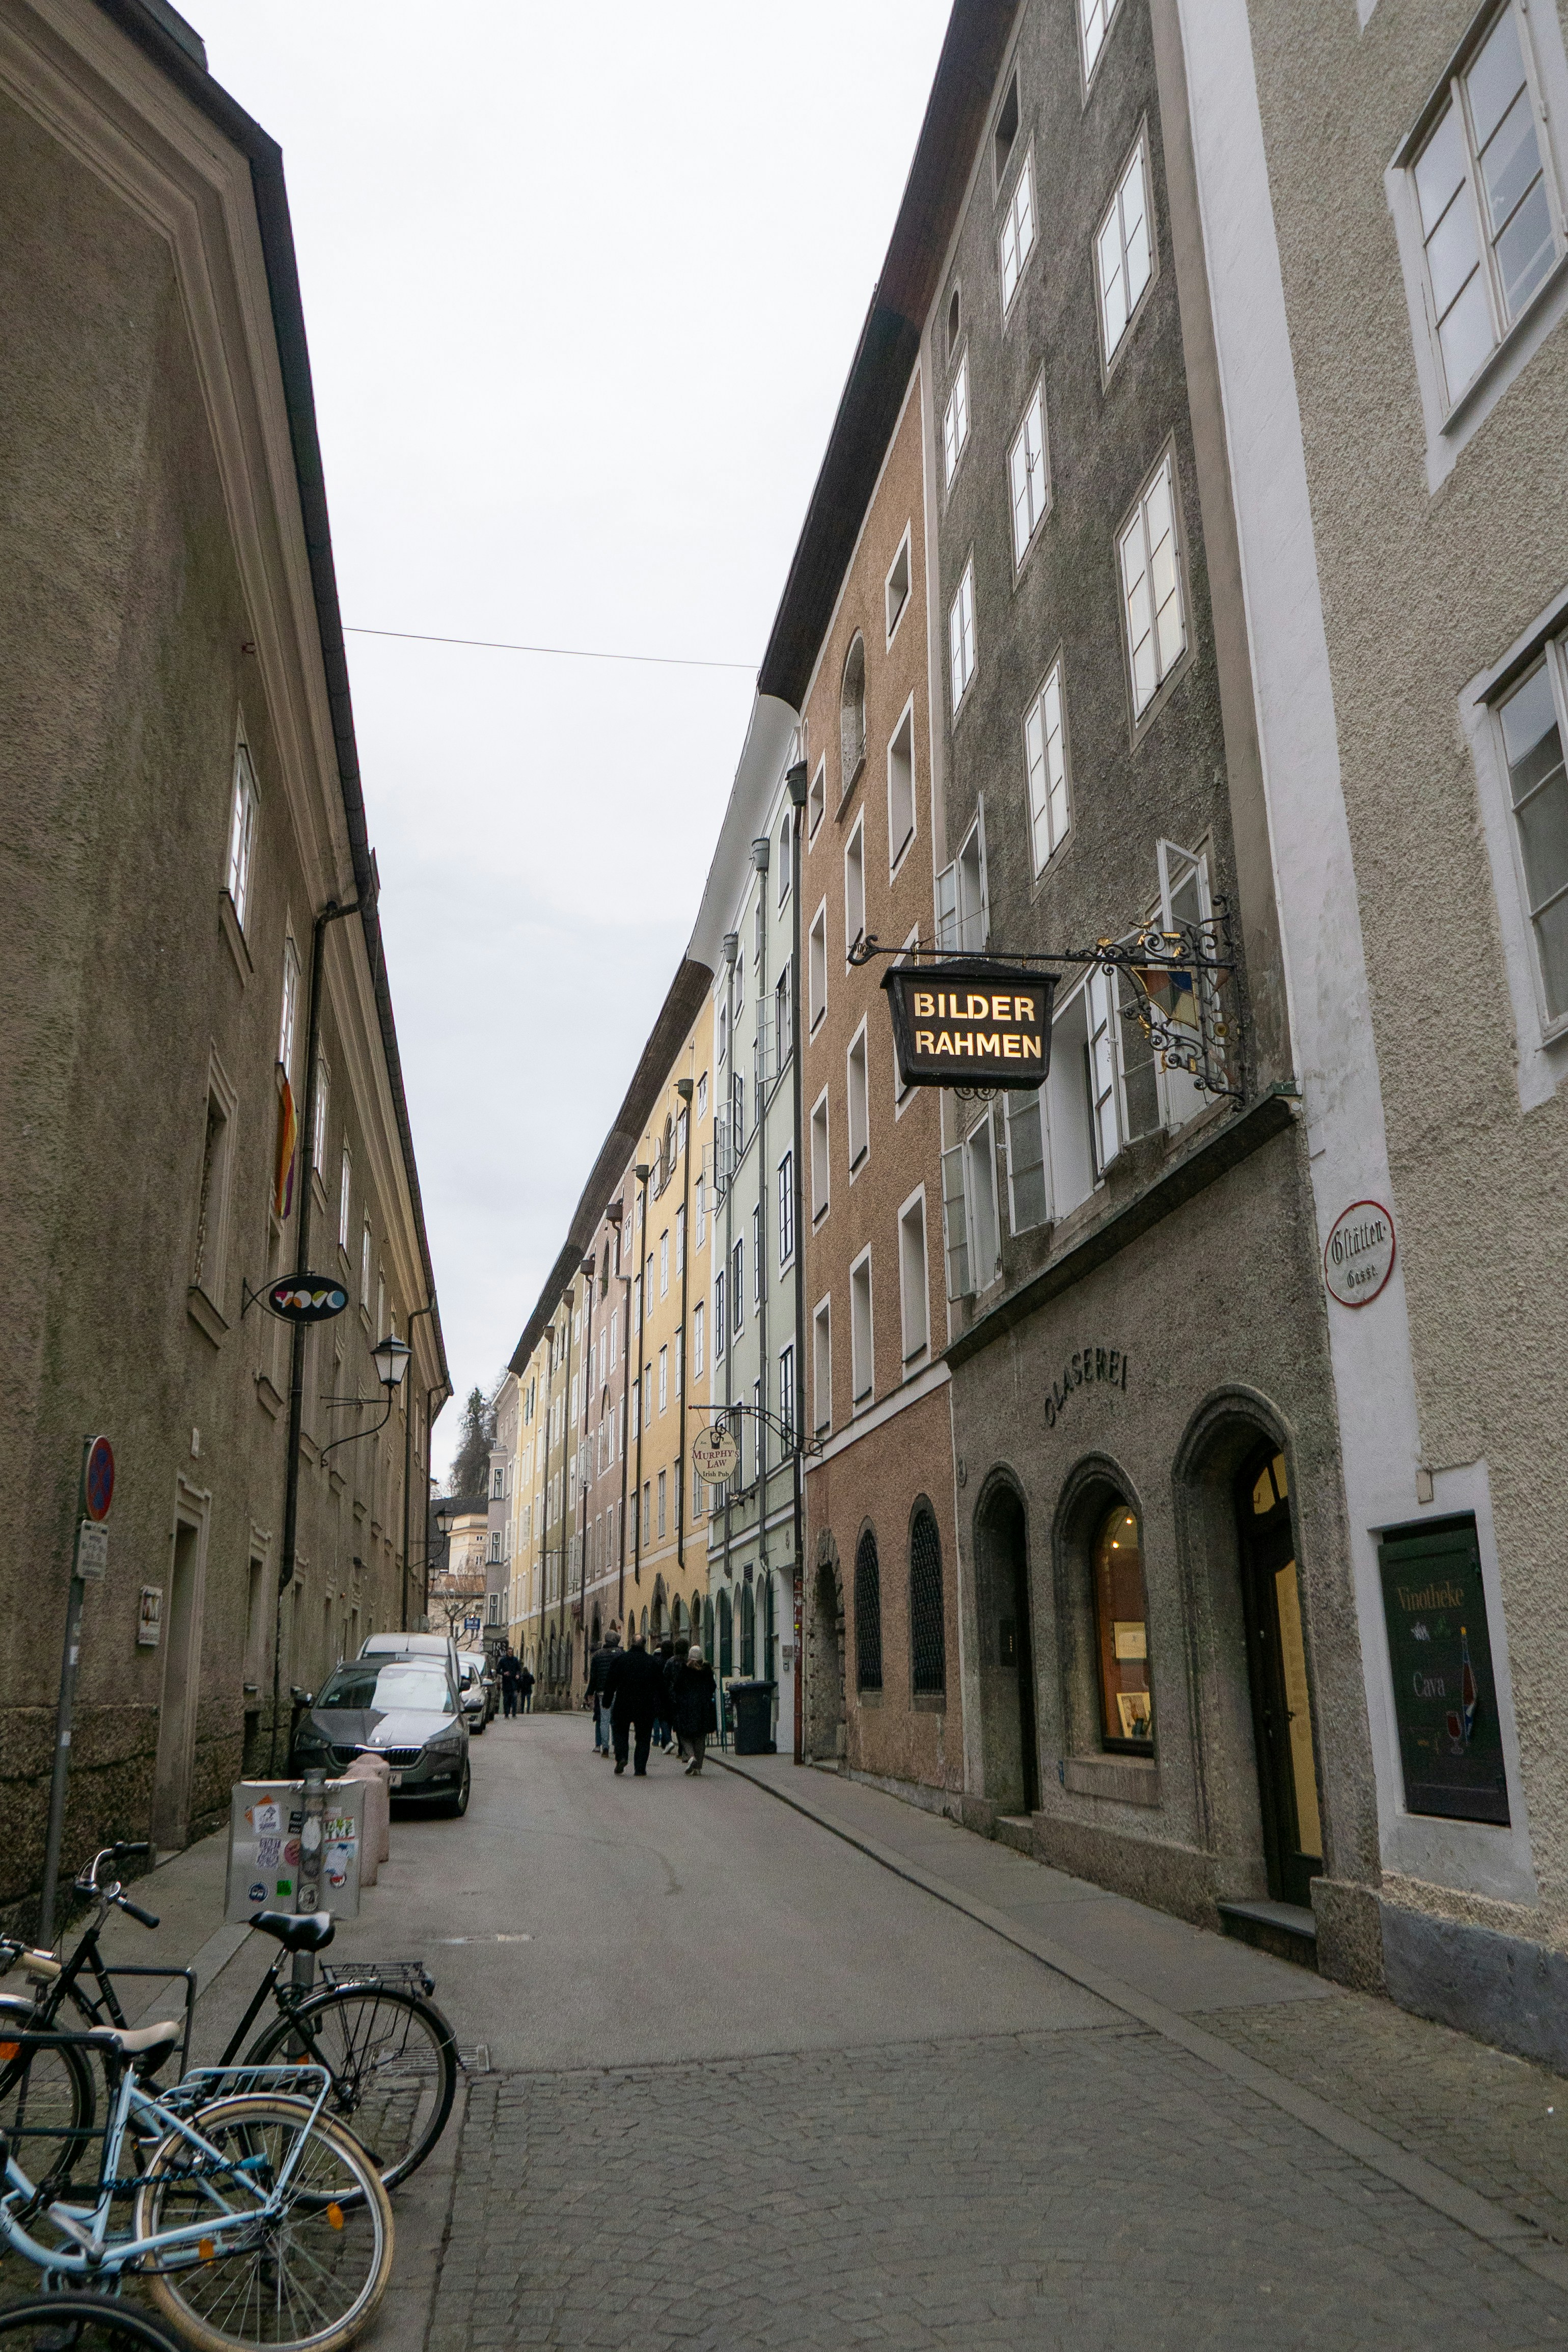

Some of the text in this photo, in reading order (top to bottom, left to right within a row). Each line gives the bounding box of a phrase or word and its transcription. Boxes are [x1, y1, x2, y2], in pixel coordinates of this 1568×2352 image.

[914, 993, 1035, 1021] BILDER
[916, 1031, 1041, 1058] RAHMEN
[1044, 1347, 1127, 1427] GLASEREI
[692, 1450, 739, 1460] MURPHY'S
[707, 1459, 727, 1469] LAW
[1397, 1580, 1465, 1611] Vinotheke
[1413, 1672, 1446, 1698] Cava
